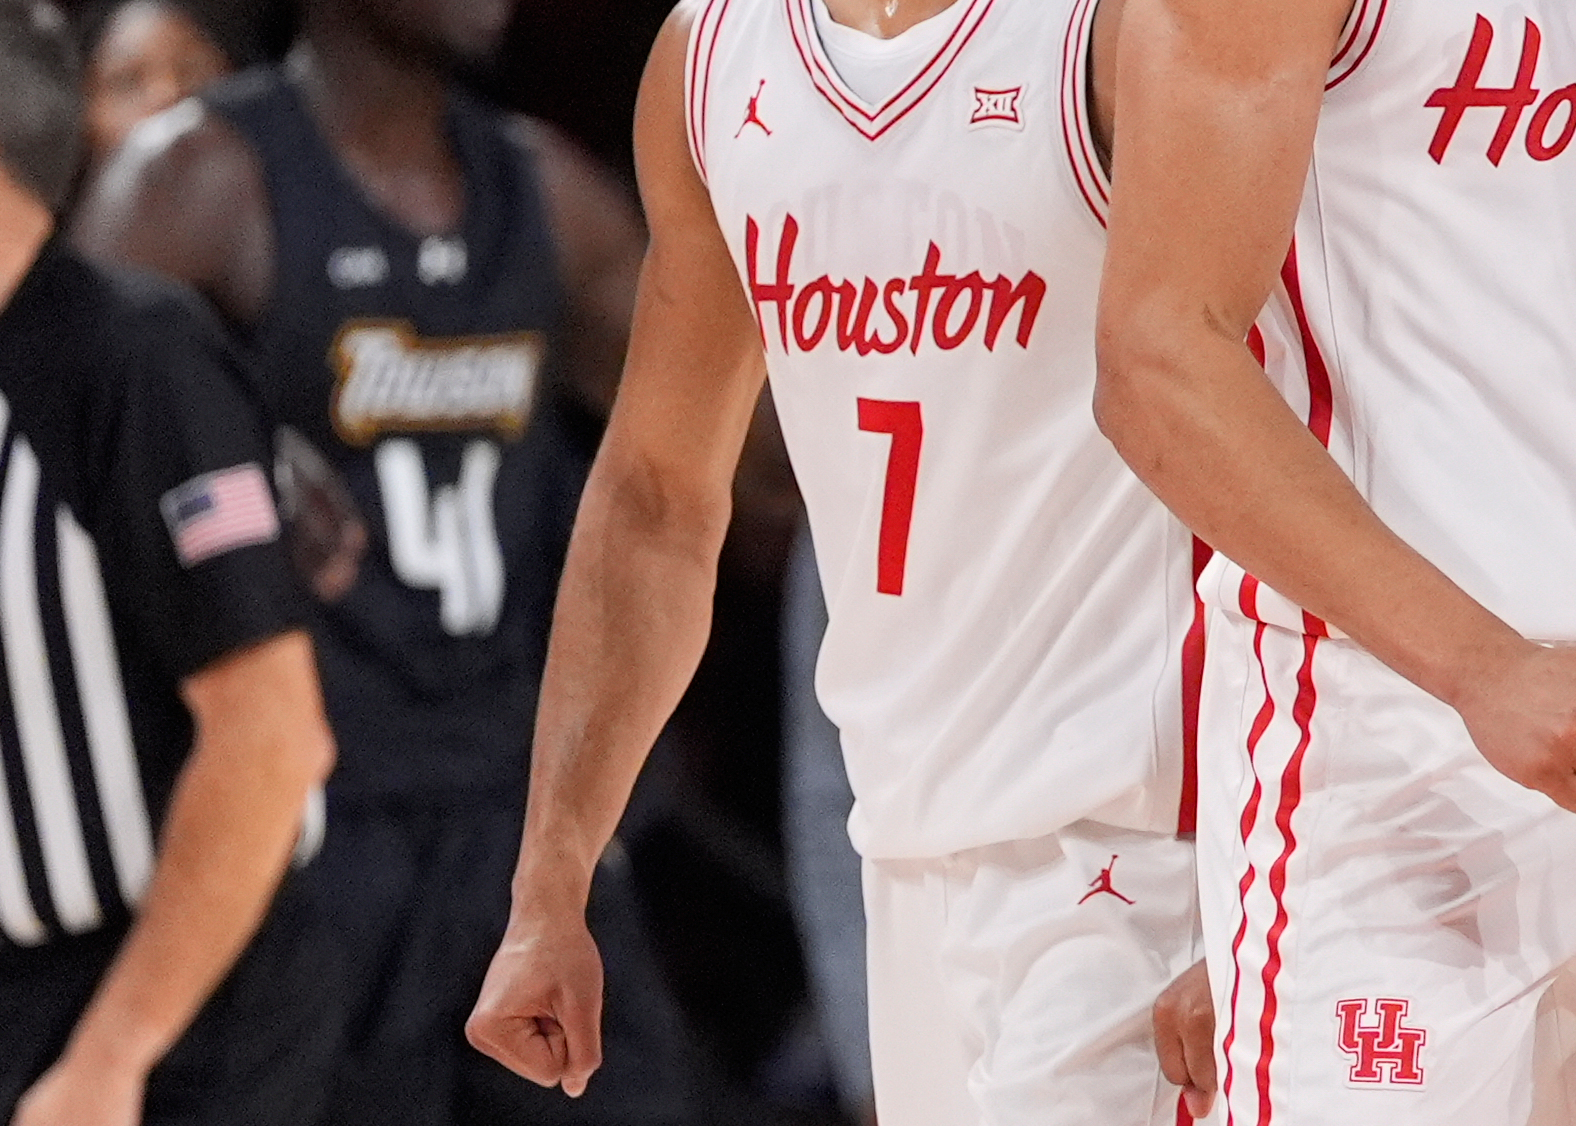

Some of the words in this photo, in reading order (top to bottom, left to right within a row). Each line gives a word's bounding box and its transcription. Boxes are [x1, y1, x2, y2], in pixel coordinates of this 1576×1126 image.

[746, 212, 1047, 357] Houston
[856, 397, 924, 596] 7
[1336, 998, 1425, 1084] UH
